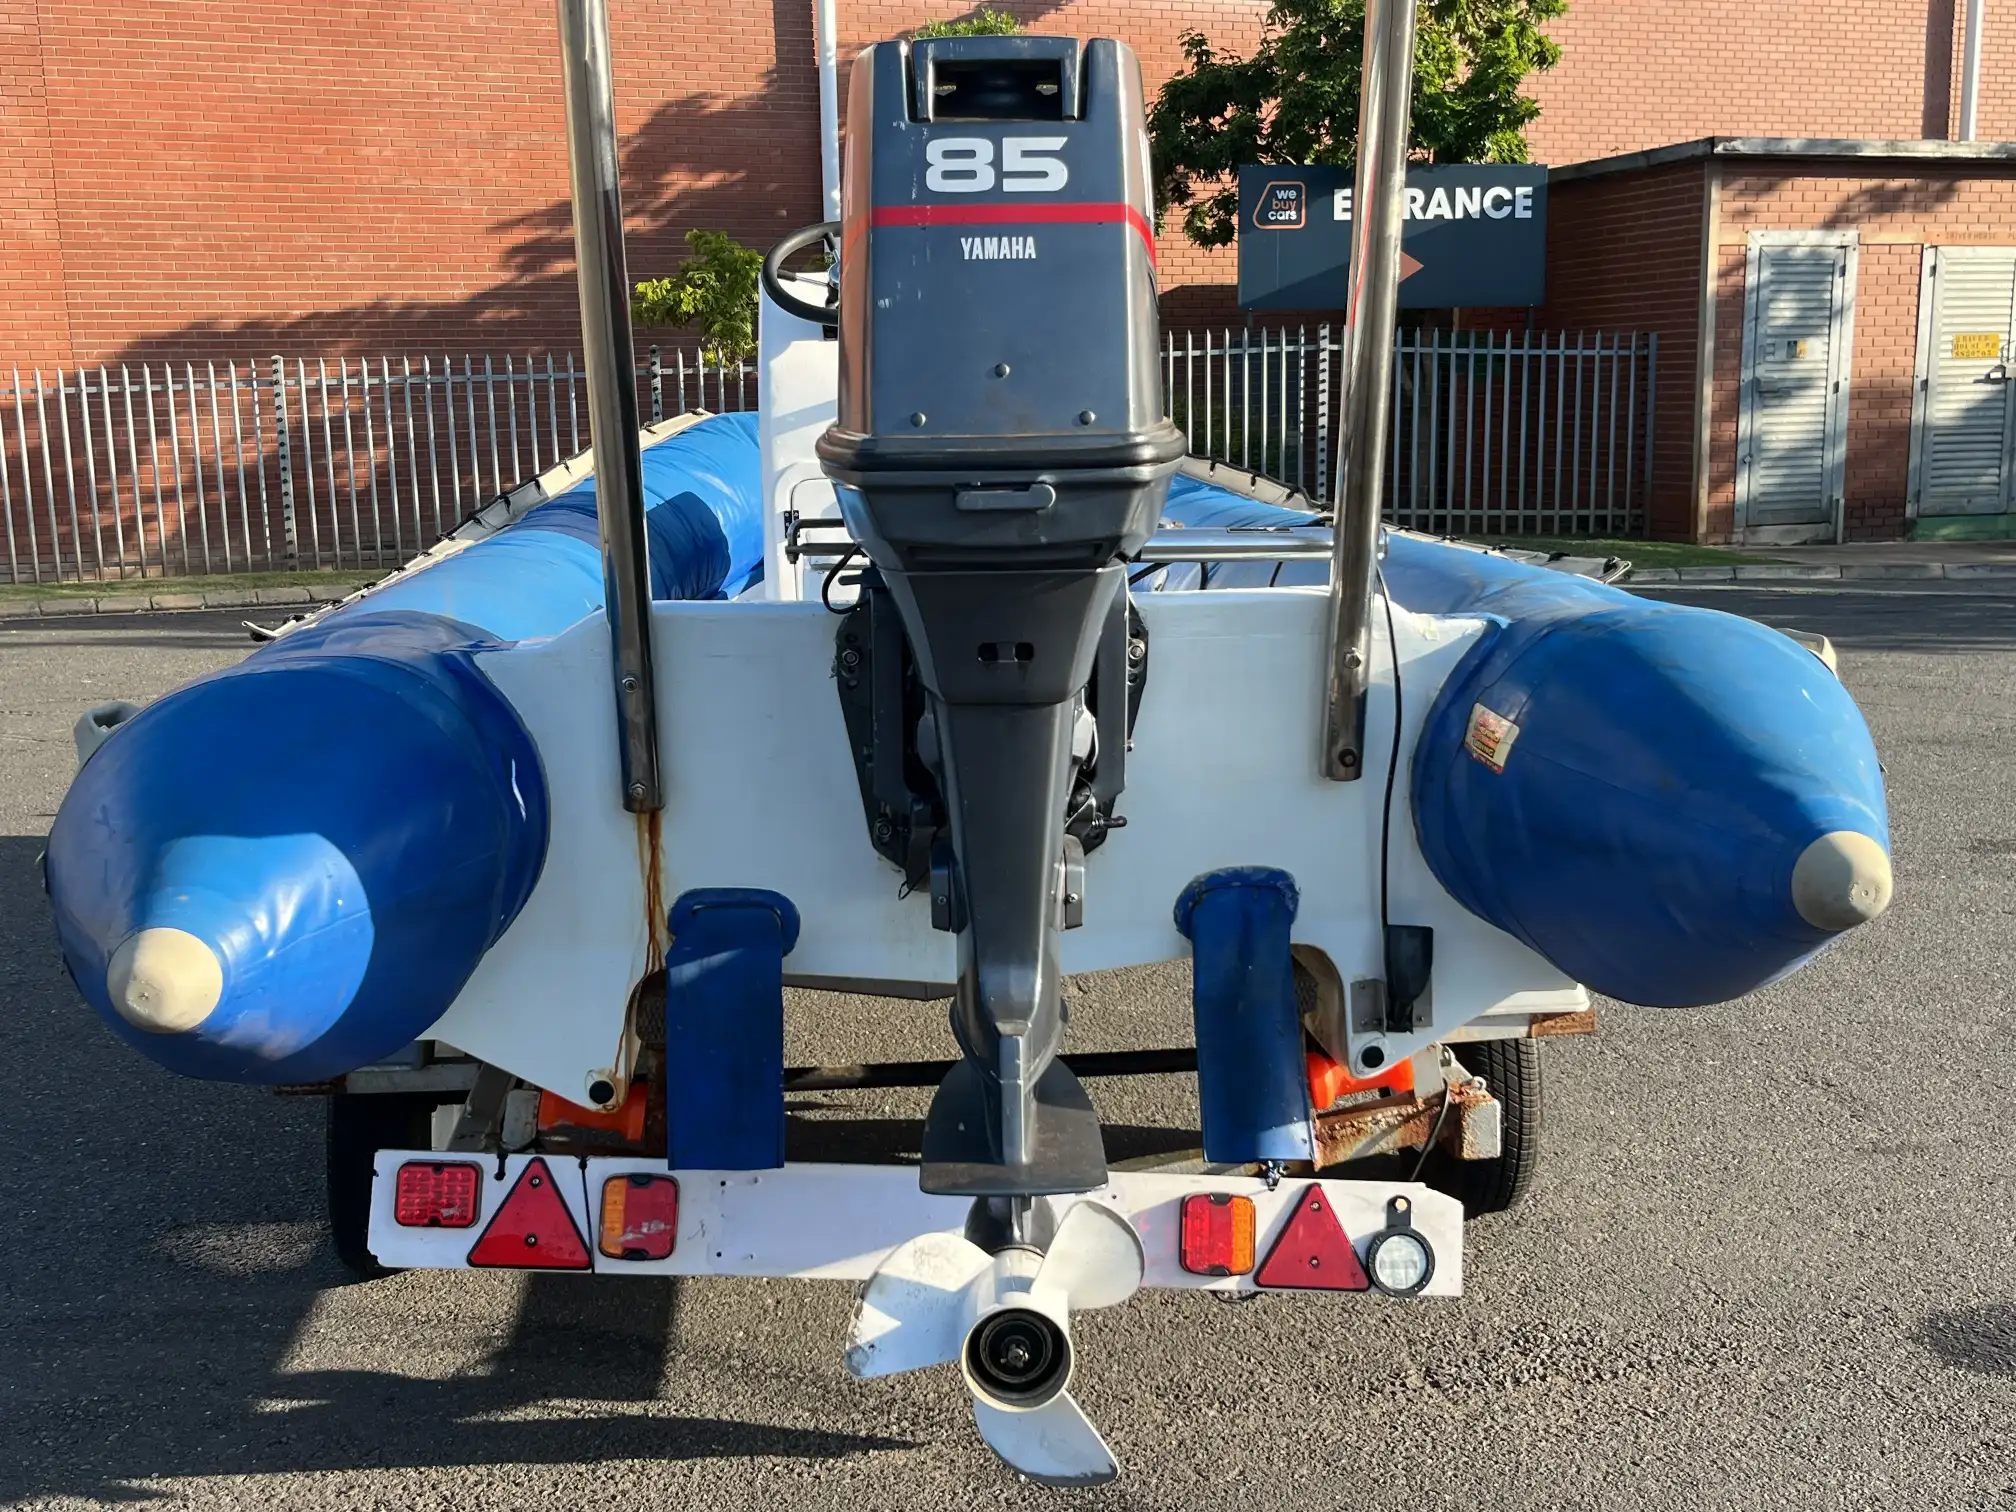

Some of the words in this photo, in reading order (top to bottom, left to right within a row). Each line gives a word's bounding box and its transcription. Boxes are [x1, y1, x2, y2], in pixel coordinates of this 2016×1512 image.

[926, 137, 1068, 192] 85
[1276, 190, 1297, 199] we
[1333, 187, 1533, 220] ERANCE
[1272, 198, 1297, 211] buy
[1268, 210, 1297, 220] cars
[960, 236, 1036, 260] YAMAHA
